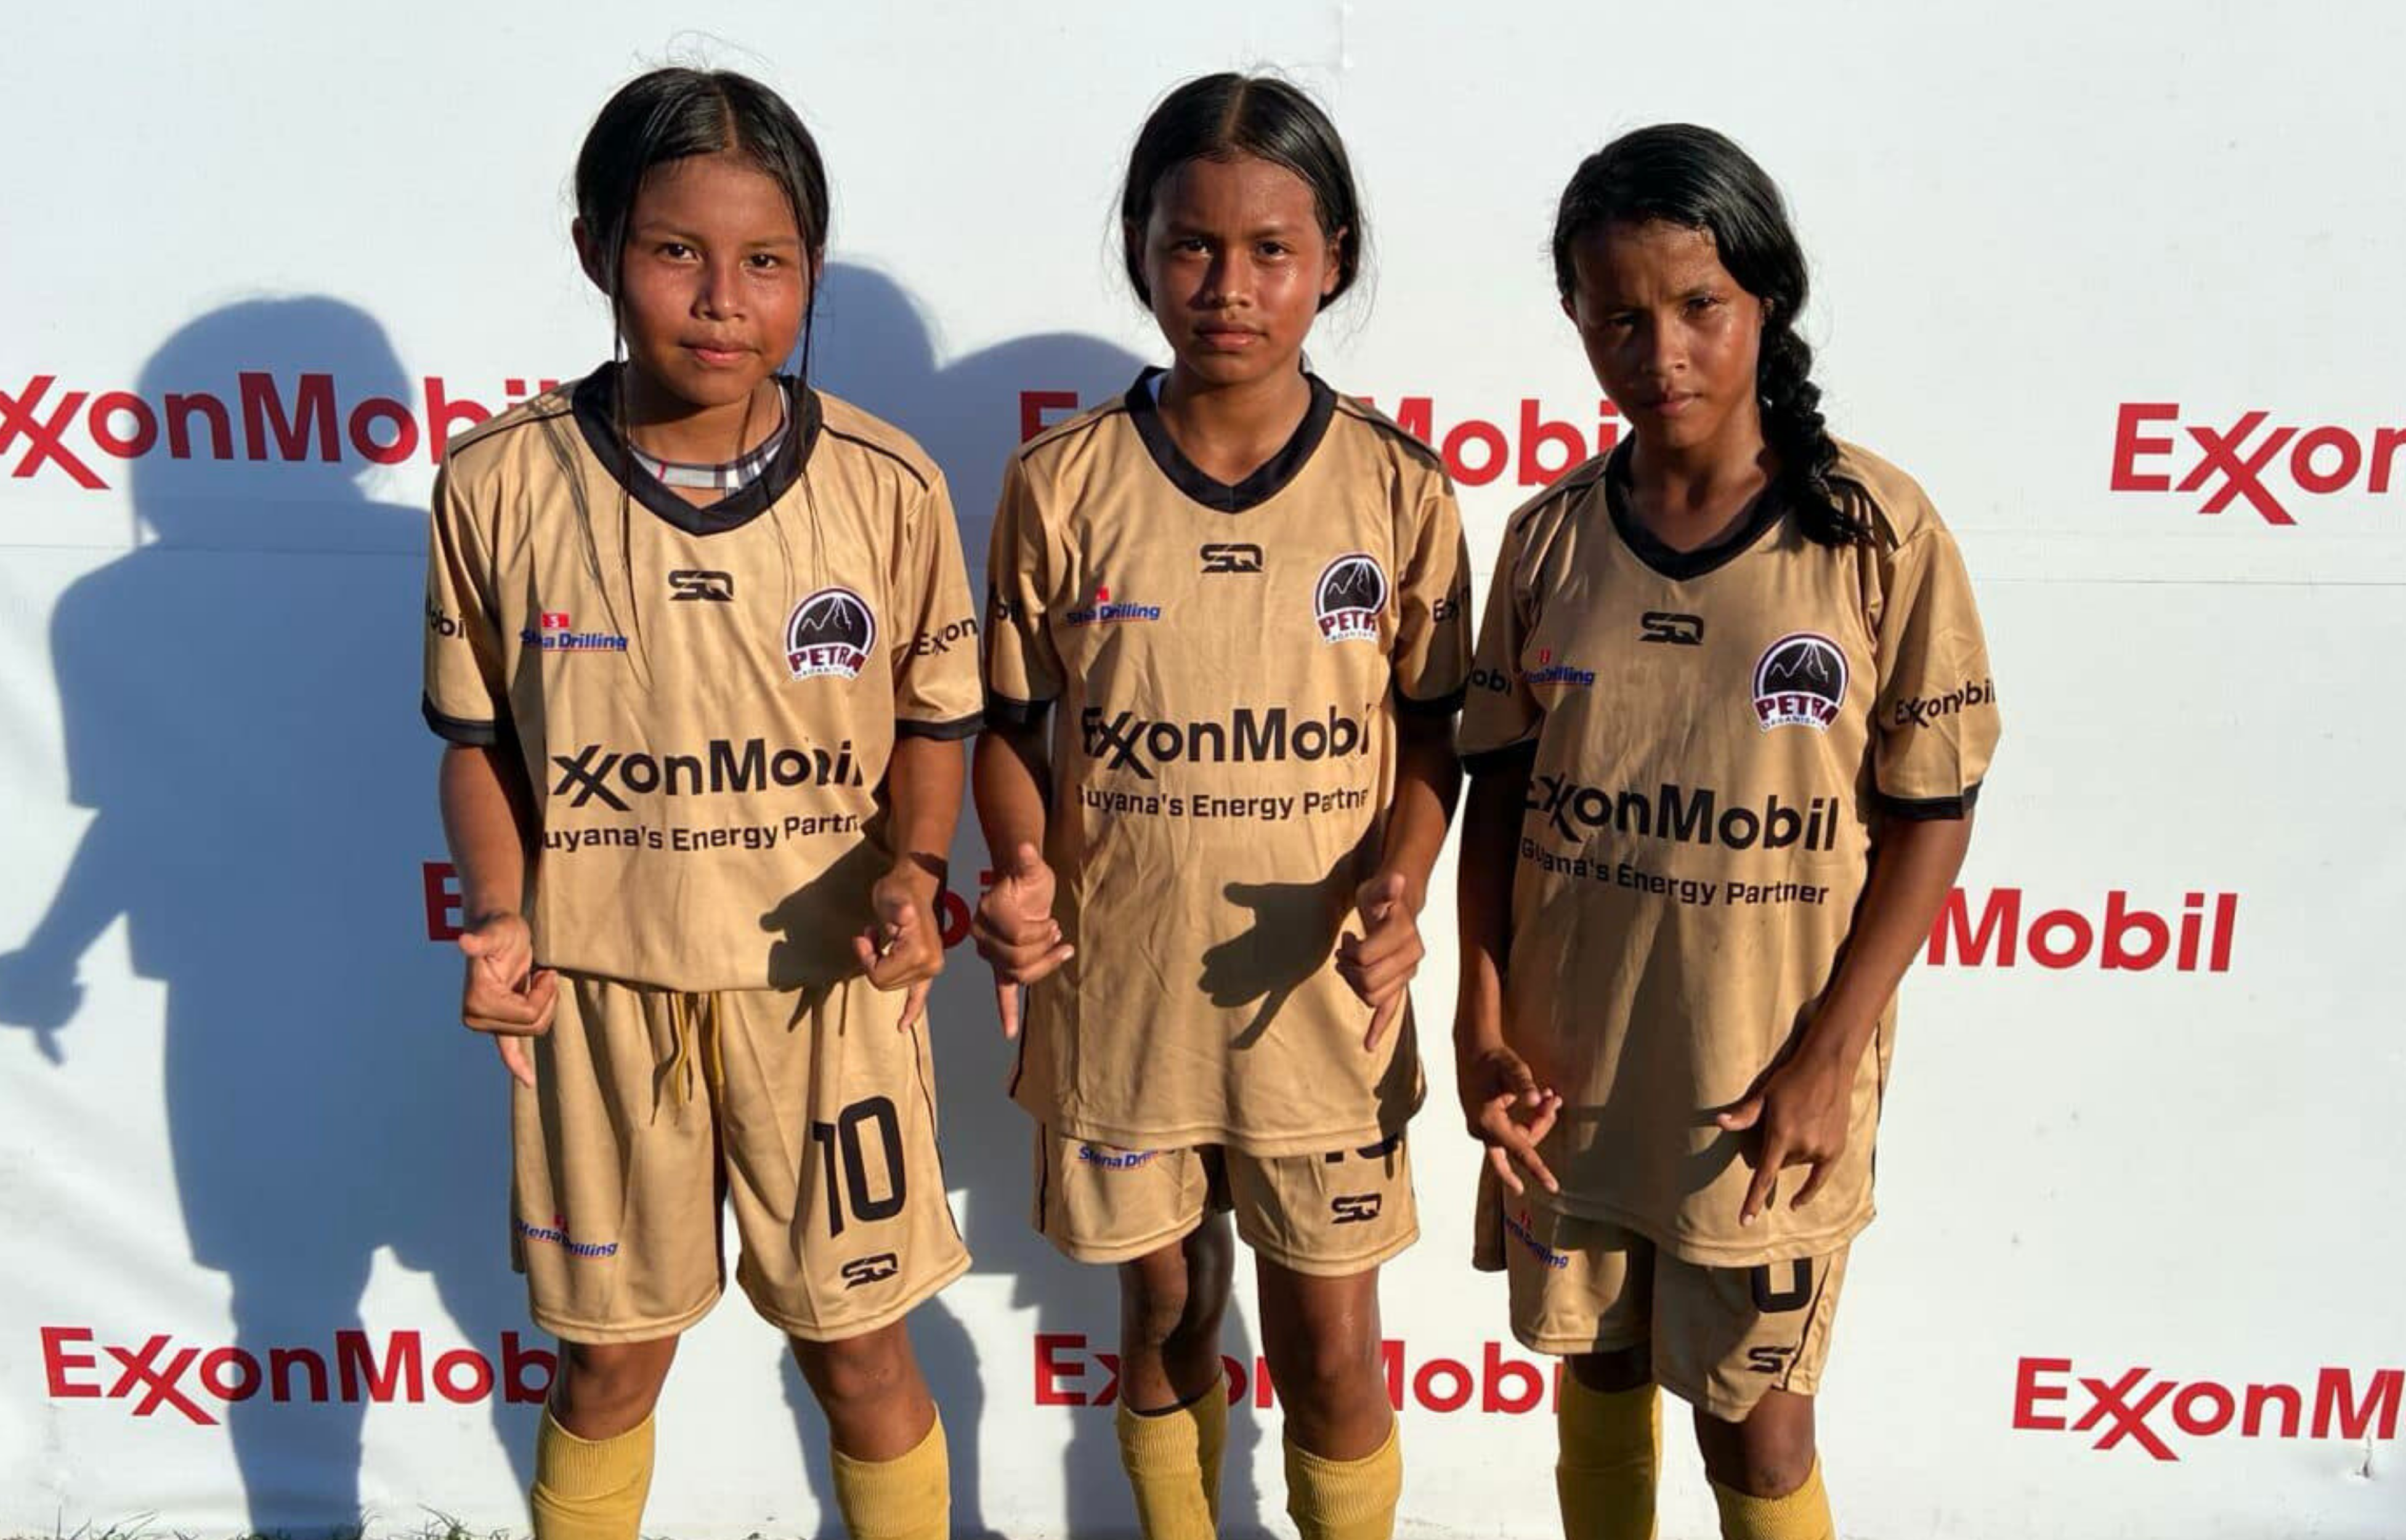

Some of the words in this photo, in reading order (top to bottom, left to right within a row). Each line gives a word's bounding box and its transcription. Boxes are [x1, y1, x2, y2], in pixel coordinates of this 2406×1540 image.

[559, 632, 628, 651] Drilling
[788, 646, 866, 673] PETRA
[1756, 694, 1839, 726] PETRA
[1077, 785, 1184, 817] uyana's
[1192, 794, 1294, 821] Energy
[543, 826, 663, 853] uyana's
[671, 825, 778, 852] Energy
[1617, 862, 1717, 905] Energy
[1725, 881, 1829, 905] Partner
[812, 1095, 907, 1239] 10
[1745, 1340, 1799, 1373] S
[40, 1326, 559, 1425] ExxonMob
[2012, 1356, 2405, 1462] ExxonM
